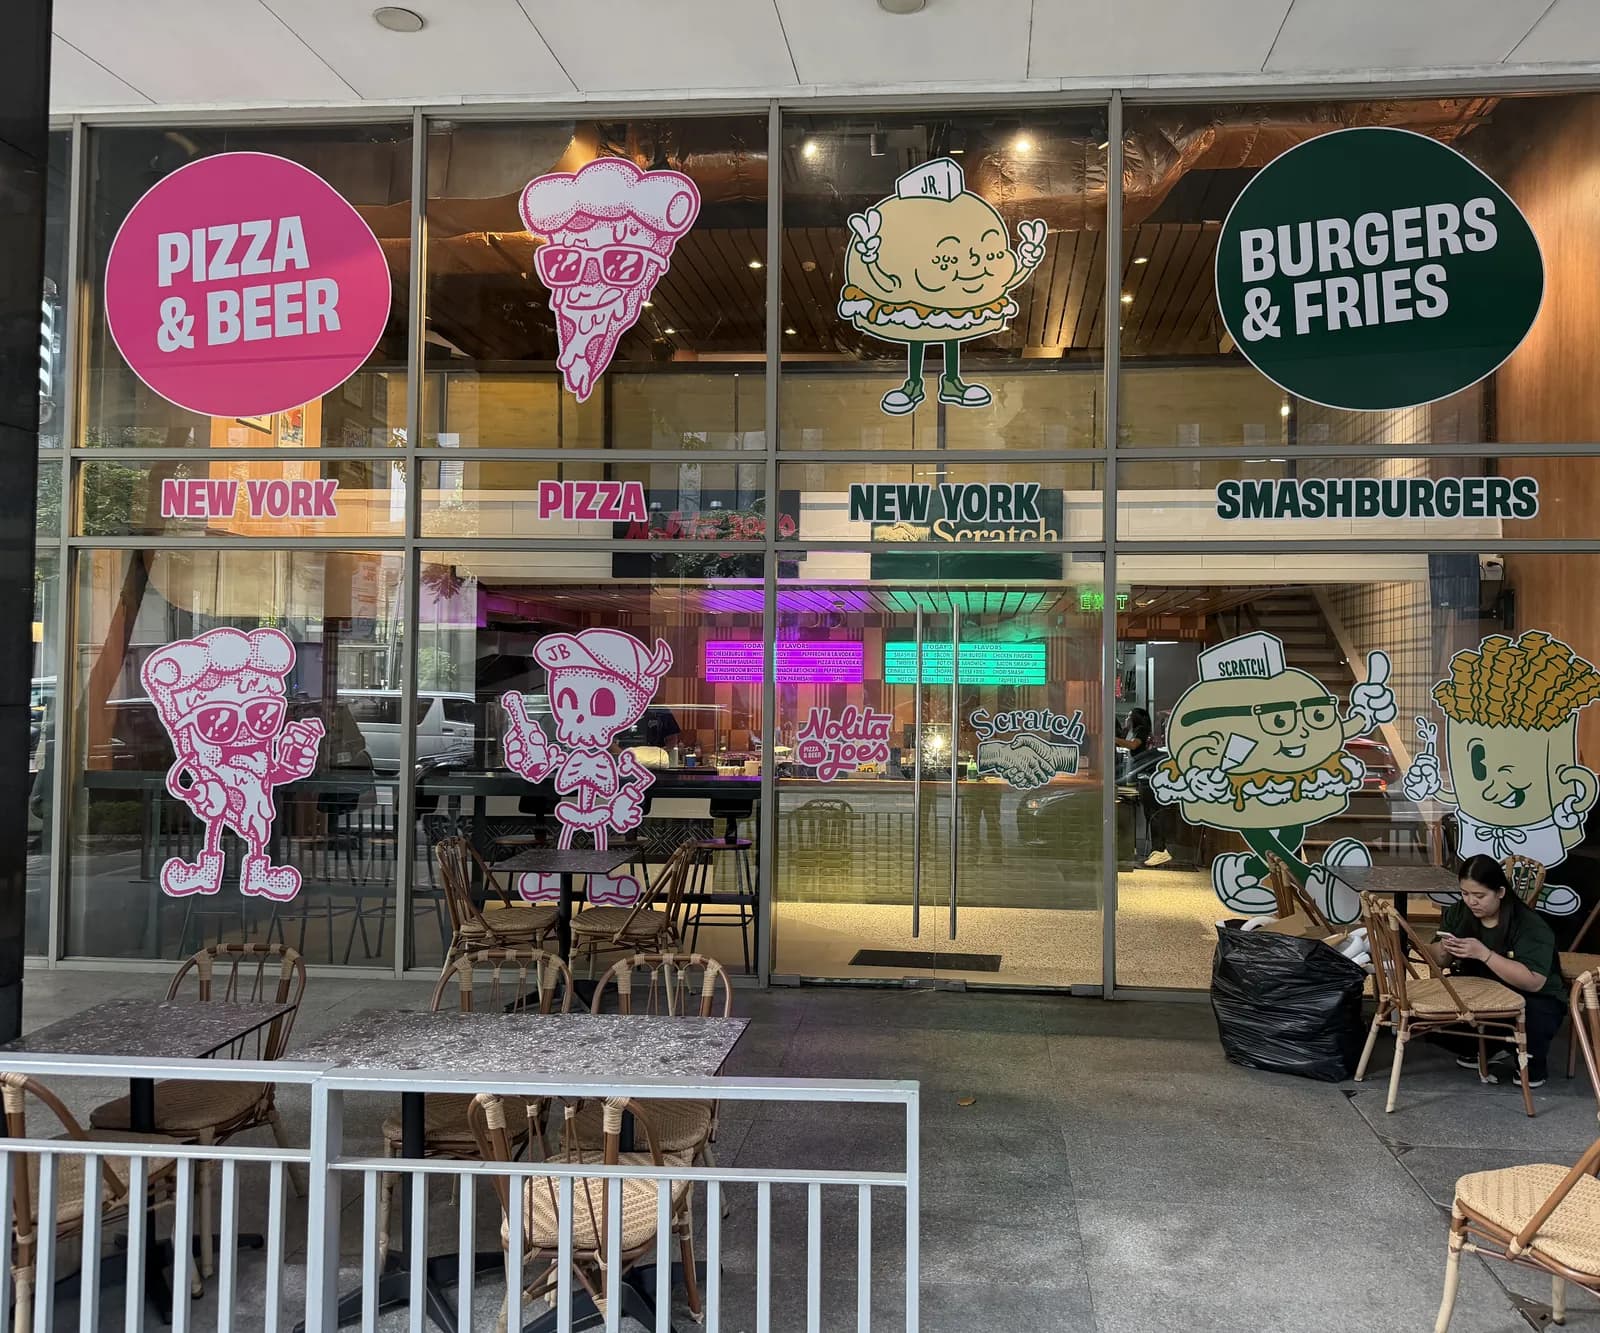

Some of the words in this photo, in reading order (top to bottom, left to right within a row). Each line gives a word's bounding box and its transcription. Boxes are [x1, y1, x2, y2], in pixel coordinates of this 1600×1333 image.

[921, 175, 942, 196] JR.
[157, 215, 310, 288] PIZZA
[1240, 197, 1498, 283] BURGERS
[157, 296, 195, 353] &
[206, 277, 341, 346] BEER
[1241, 287, 1282, 342] &
[1293, 263, 1449, 335] FRIES
[161, 479, 239, 519] NEW
[245, 479, 339, 519] YORK
[538, 480, 648, 522] PIZZA
[849, 483, 932, 522] NEW
[939, 482, 1041, 523] YORK
[1216, 478, 1538, 520] SMASHBURGERS
[1080, 594, 1129, 610] EXT
[545, 643, 571, 662] JB
[1218, 657, 1267, 677] SCRATCH
[797, 705, 893, 741] Nolita
[970, 709, 1085, 745] Scratch
